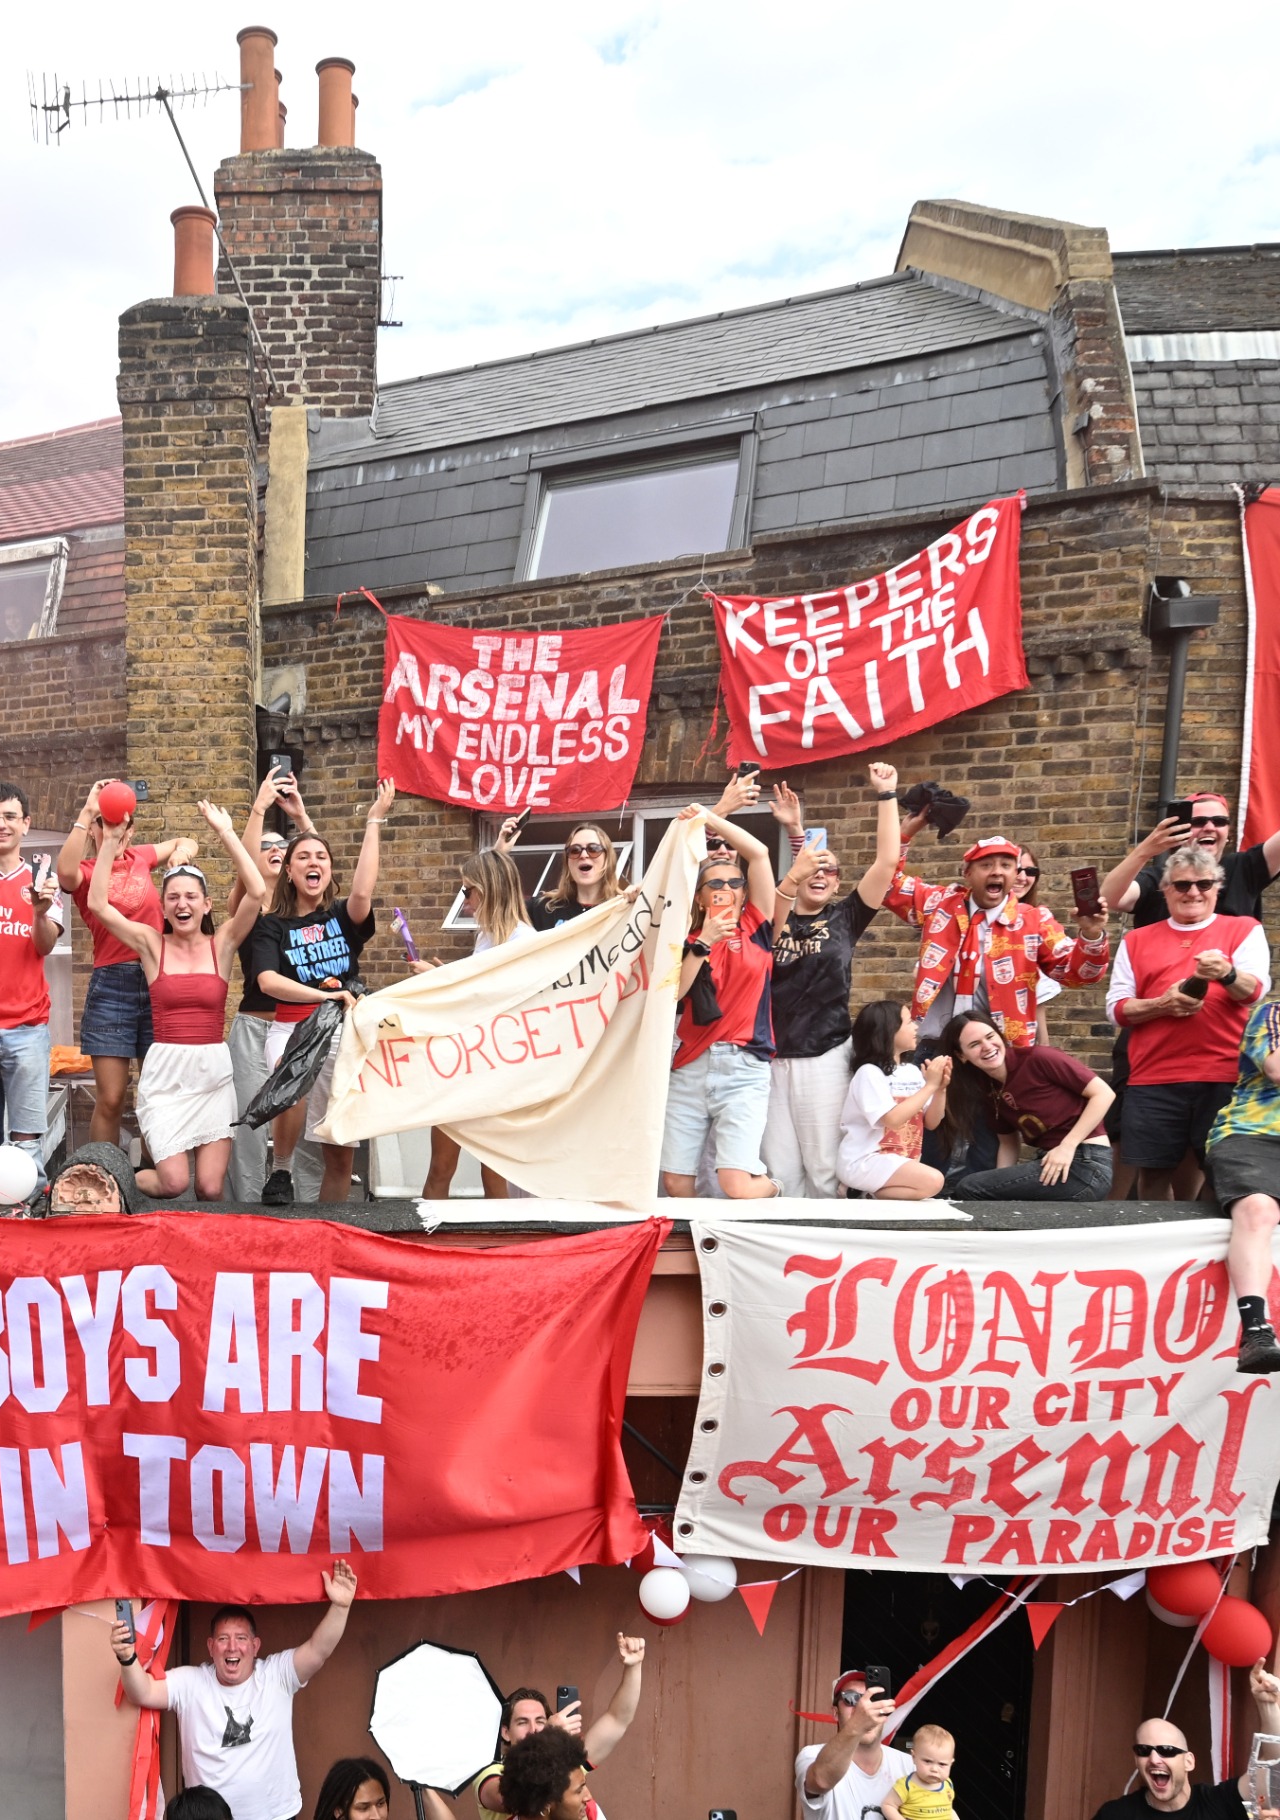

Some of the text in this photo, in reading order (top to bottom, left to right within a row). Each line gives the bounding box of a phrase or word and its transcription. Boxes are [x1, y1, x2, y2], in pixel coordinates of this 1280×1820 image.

[724, 506, 1000, 658] KEEPERS
[472, 635, 562, 673] THE
[785, 581, 956, 680] OF THE
[384, 653, 640, 722] ARSENAL
[748, 607, 991, 756] FAITH
[395, 714, 631, 765] MY ENDLESS
[448, 760, 557, 807] LOVE
[285, 946, 308, 965] THE
[289, 917, 342, 947] PARTY ON
[296, 955, 349, 983] OF LONDON
[202, 1271, 390, 1424] ARE
[890, 1372, 1185, 1432] OUR CITY
[718, 1378, 1271, 1518] Arsenal
[122, 1432, 385, 1555] TOWN
[763, 1503, 1235, 1566] OUR PARADISE
